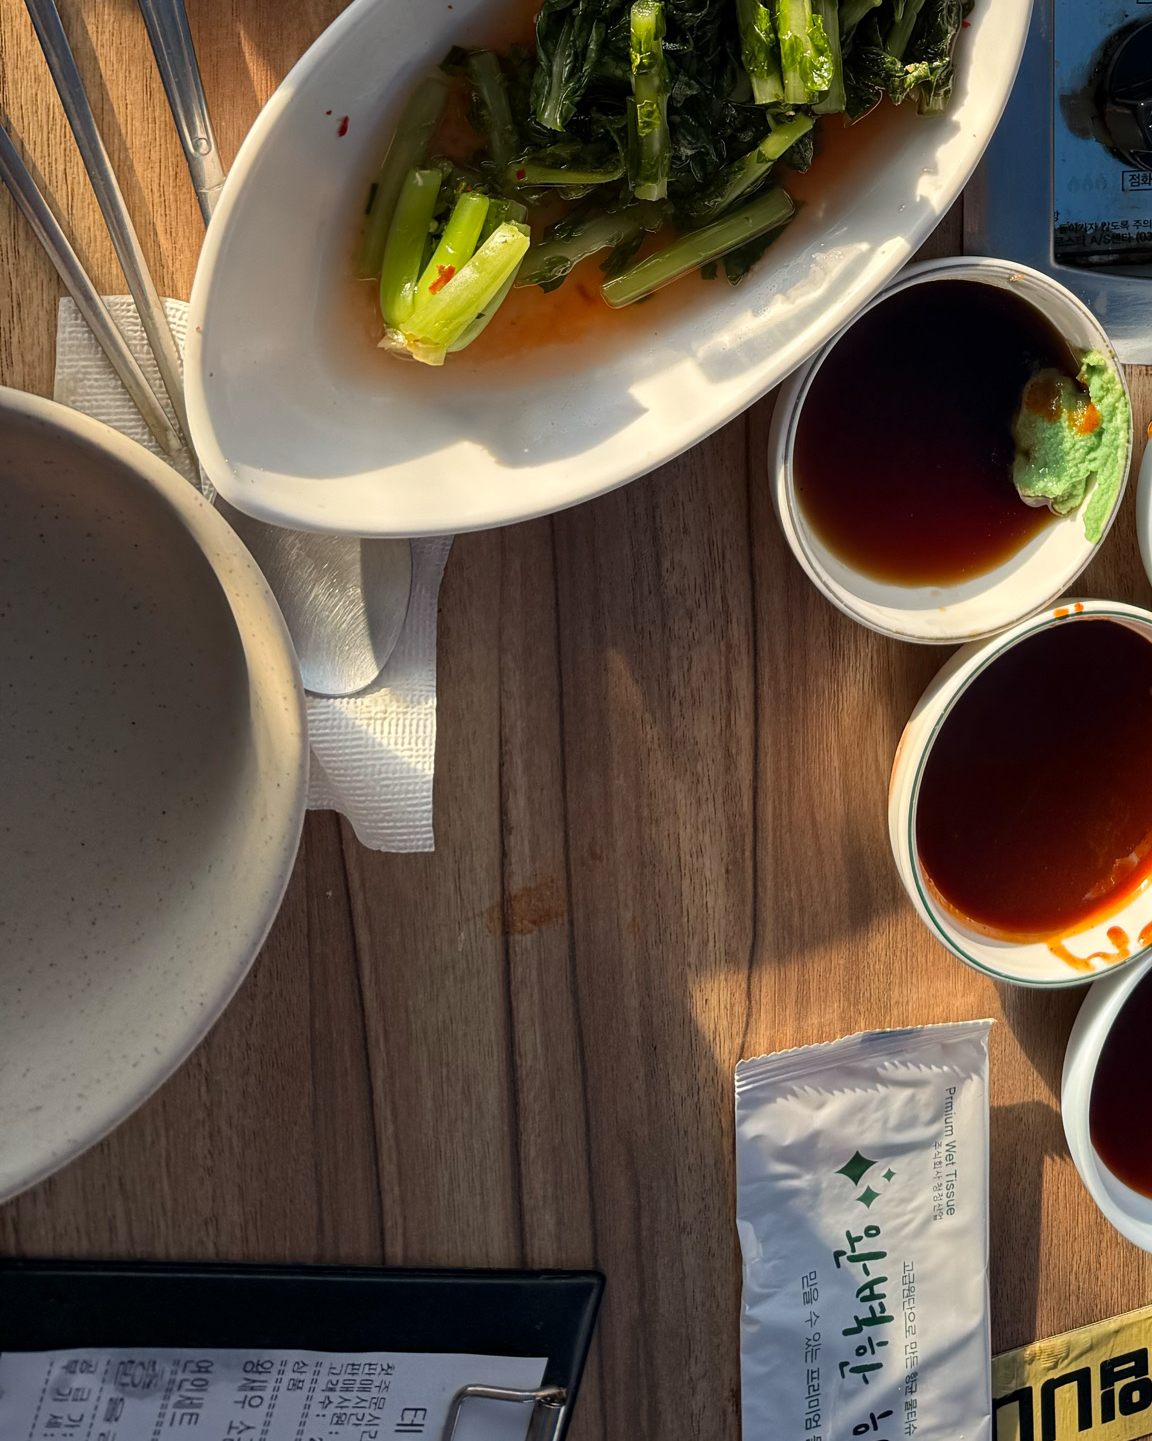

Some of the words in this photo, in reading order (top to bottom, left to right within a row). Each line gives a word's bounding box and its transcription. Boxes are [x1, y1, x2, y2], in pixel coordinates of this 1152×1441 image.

[1128, 173, 1152, 187] 점화
[1132, 218, 1152, 230] 주의
[944, 1086, 957, 1137] Prmium
[945, 1140, 957, 1167] Wet
[945, 1170, 957, 1216] Tissue
[801, 1270, 819, 1306] 믿을
[833, 1225, 895, 1385] 완벽한
[902, 1261, 917, 1339] 고급원단으로
[804, 1311, 820, 1328] 수
[804, 1332, 821, 1363] 있는
[904, 1341, 919, 1369] 만든
[804, 1367, 822, 1430] 프리미엄
[904, 1398, 918, 1436] 물티슈
